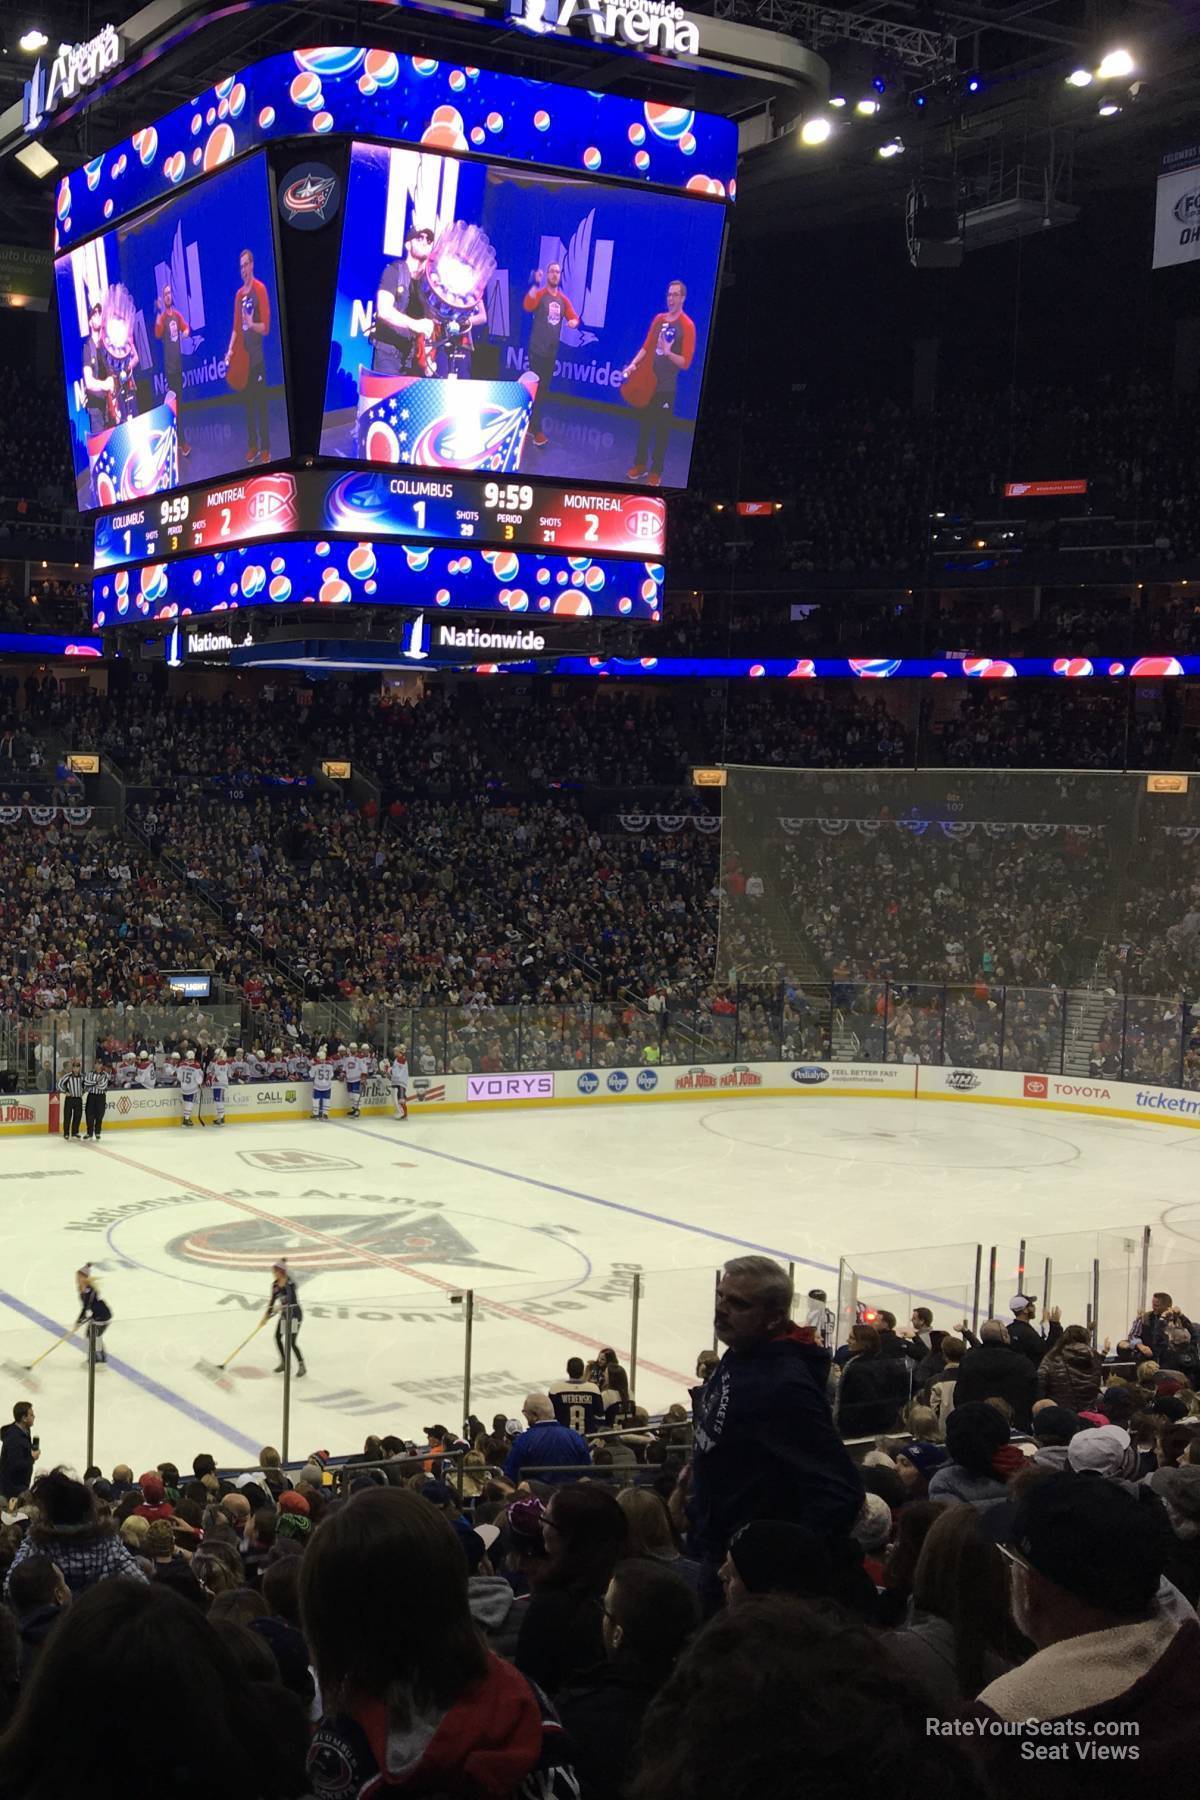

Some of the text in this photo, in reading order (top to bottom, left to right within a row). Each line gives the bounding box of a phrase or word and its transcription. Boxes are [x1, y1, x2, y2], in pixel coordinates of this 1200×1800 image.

[557, 0, 699, 54] Arena
[46, 34, 118, 110] Arena
[207, 486, 246, 507] MONTREAL
[390, 479, 453, 498] COLUMBUS
[484, 482, 534, 510] 9:59
[160, 496, 189, 524] 9:59
[563, 494, 623, 512] MONTREAL
[112, 511, 144, 529] COLUMBUS
[220, 508, 231, 536] 2
[412, 501, 426, 529] 1
[456, 510, 479, 521] SHOTS
[497, 513, 522, 525] PERIOD
[539, 517, 562, 527] SHOTS
[504, 525, 514, 540] 3
[584, 514, 599, 541] 2
[123, 530, 131, 555] 1
[171, 537, 177, 550] 3
[543, 530, 556, 542] 21
[440, 626, 545, 650] Nationwide
[229, 790, 244, 799] 105
[185, 982, 207, 991] LIGHT
[182, 1072, 193, 1084] 15
[318, 1069, 330, 1080] 53
[608, 1074, 627, 1090] Kroger
[637, 1073, 657, 1089] Kroger
[676, 1074, 694, 1089] PAPA
[720, 1073, 738, 1089] PAPA
[794, 1069, 828, 1081] Pedialyte
[949, 1074, 977, 1085] NHL
[470, 1078, 551, 1096] VORYS
[579, 1075, 598, 1093] Kroger
[1054, 1084, 1112, 1099] TOYOTA
[132, 1098, 183, 1109] SECURITY
[232, 1093, 250, 1104] Gas
[257, 1092, 283, 1101] CALL
[300, 1188, 445, 1210] Arena
[217, 1293, 588, 1323] Ntionwide
[561, 1393, 593, 1405] WERENSKI
[569, 1405, 586, 1433] 8
